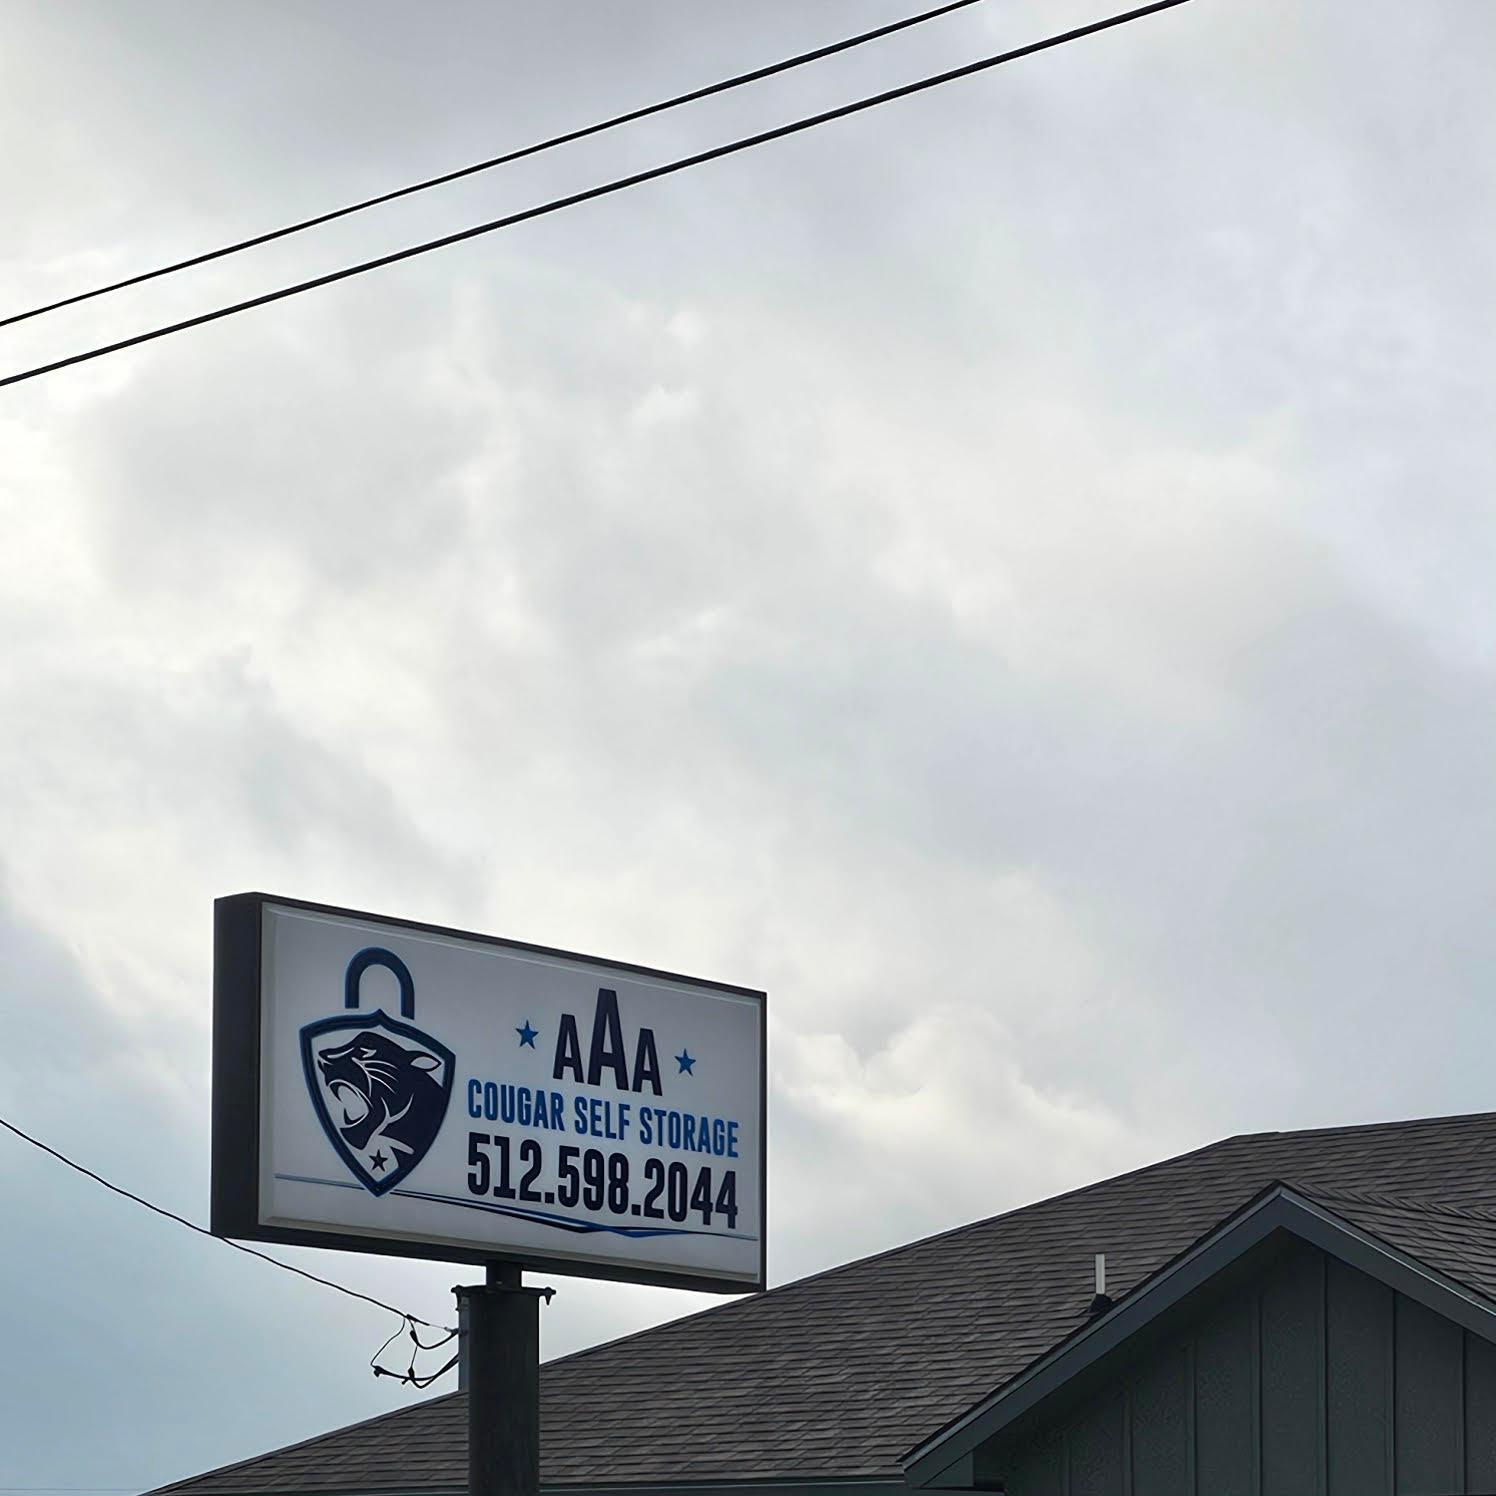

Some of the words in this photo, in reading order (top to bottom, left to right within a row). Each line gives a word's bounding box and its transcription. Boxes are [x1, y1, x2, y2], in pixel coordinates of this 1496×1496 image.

[553, 987, 663, 1097] AAA
[467, 1078, 565, 1132] COUGAR
[574, 1096, 631, 1141] SELF
[639, 1106, 739, 1158] STORAGE
[467, 1131, 738, 1230] 512.598.2044
